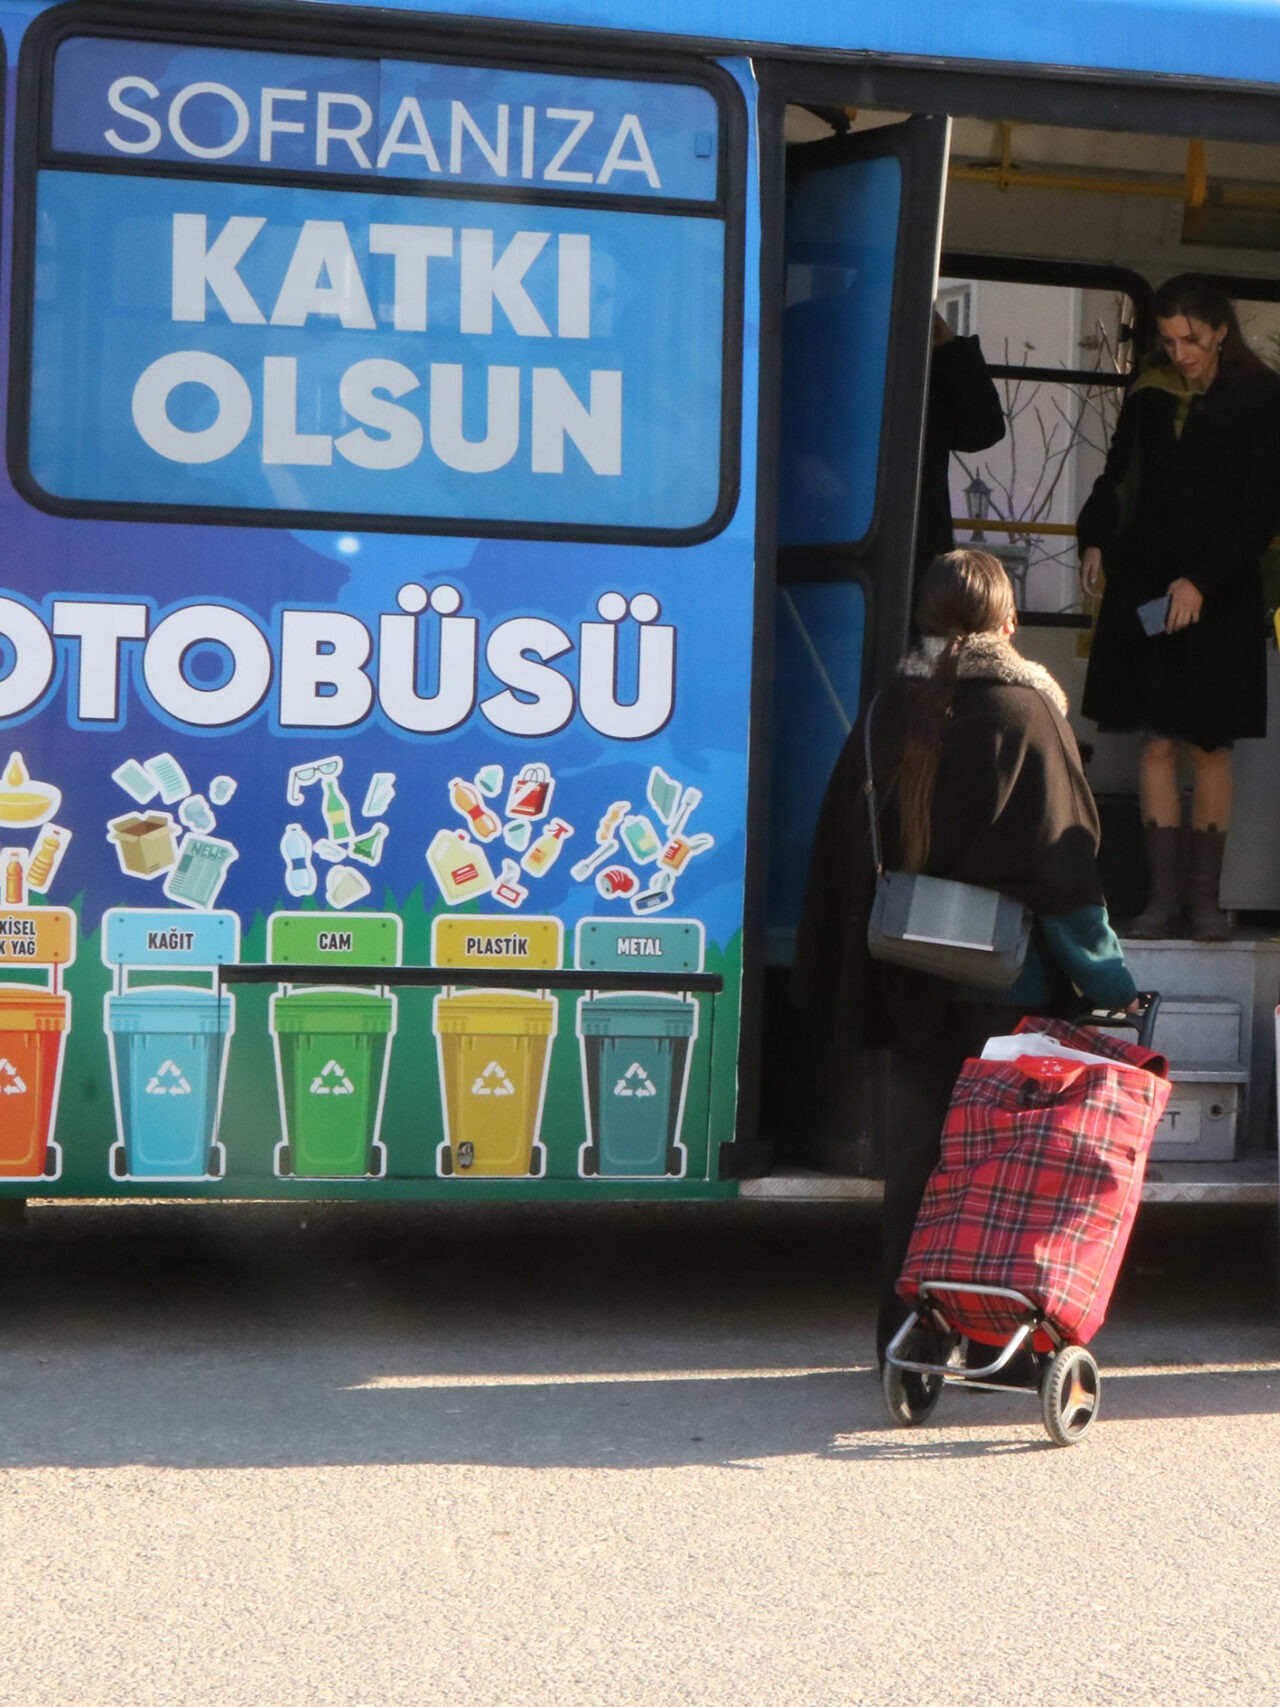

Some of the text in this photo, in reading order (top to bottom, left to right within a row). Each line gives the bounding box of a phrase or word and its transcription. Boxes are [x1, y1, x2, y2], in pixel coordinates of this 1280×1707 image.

[103, 76, 661, 188] SOFRANIZA
[172, 213, 591, 339] KATKI
[132, 350, 622, 476] OLSUN
[191, 842, 227, 860] NEWS
[11, 936, 36, 956] YAĞ
[148, 928, 194, 950] KAĞIT
[318, 932, 352, 950] CAM
[466, 933, 528, 955] PLASTİK
[616, 937, 663, 956] METAL
